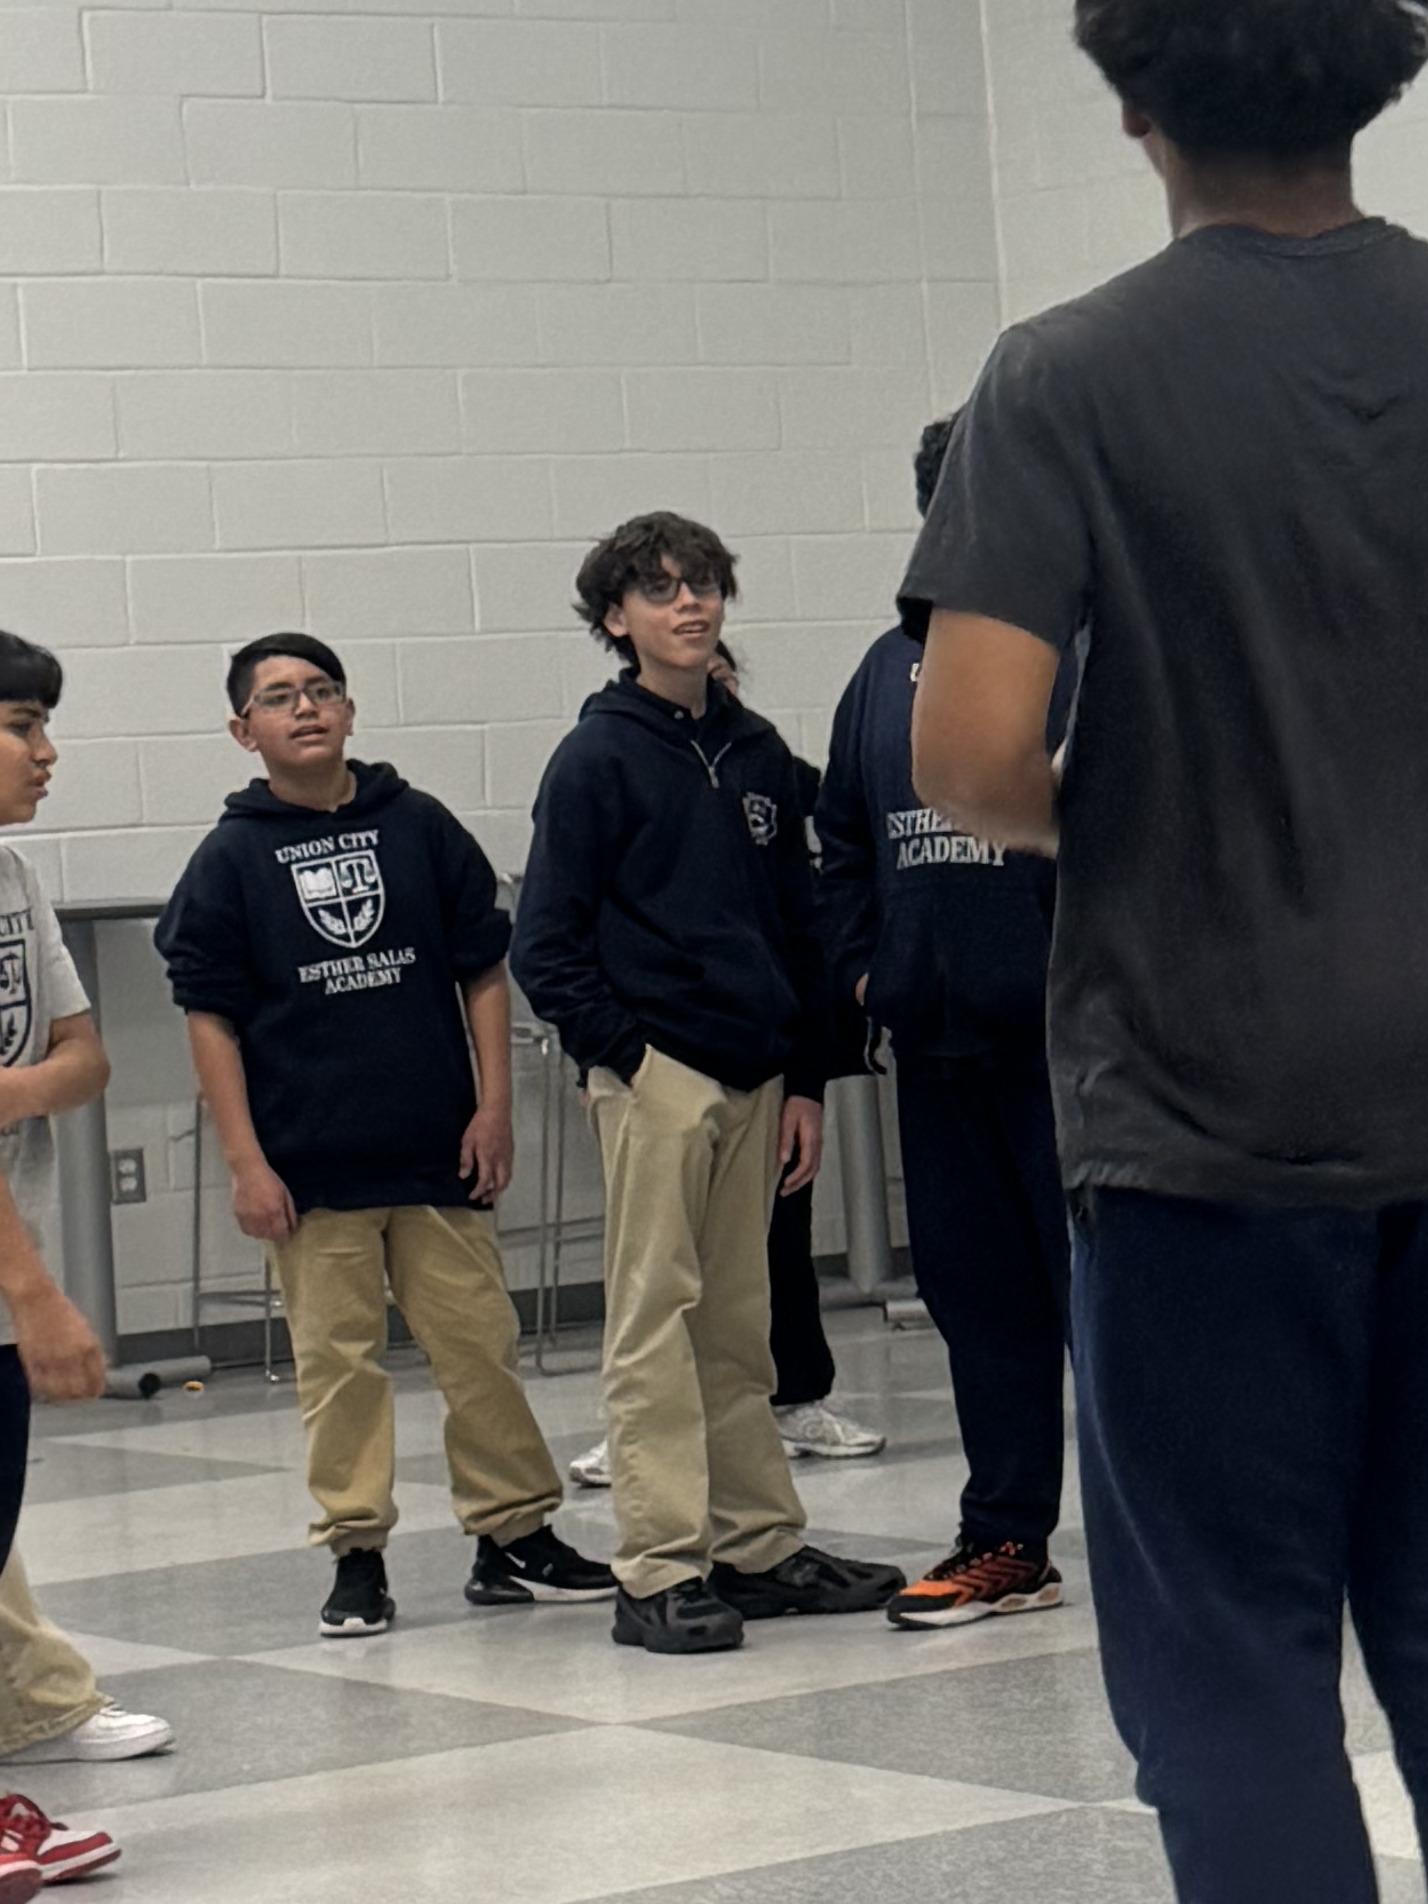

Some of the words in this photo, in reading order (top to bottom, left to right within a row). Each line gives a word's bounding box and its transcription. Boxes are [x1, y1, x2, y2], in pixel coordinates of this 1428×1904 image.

[274, 835, 336, 864] UNION
[338, 828, 379, 850] CITY
[896, 835, 1007, 871] ACADEMY
[298, 956, 366, 984] ESTHER
[366, 946, 416, 970] SALAS
[324, 967, 402, 995] ACADEMY
